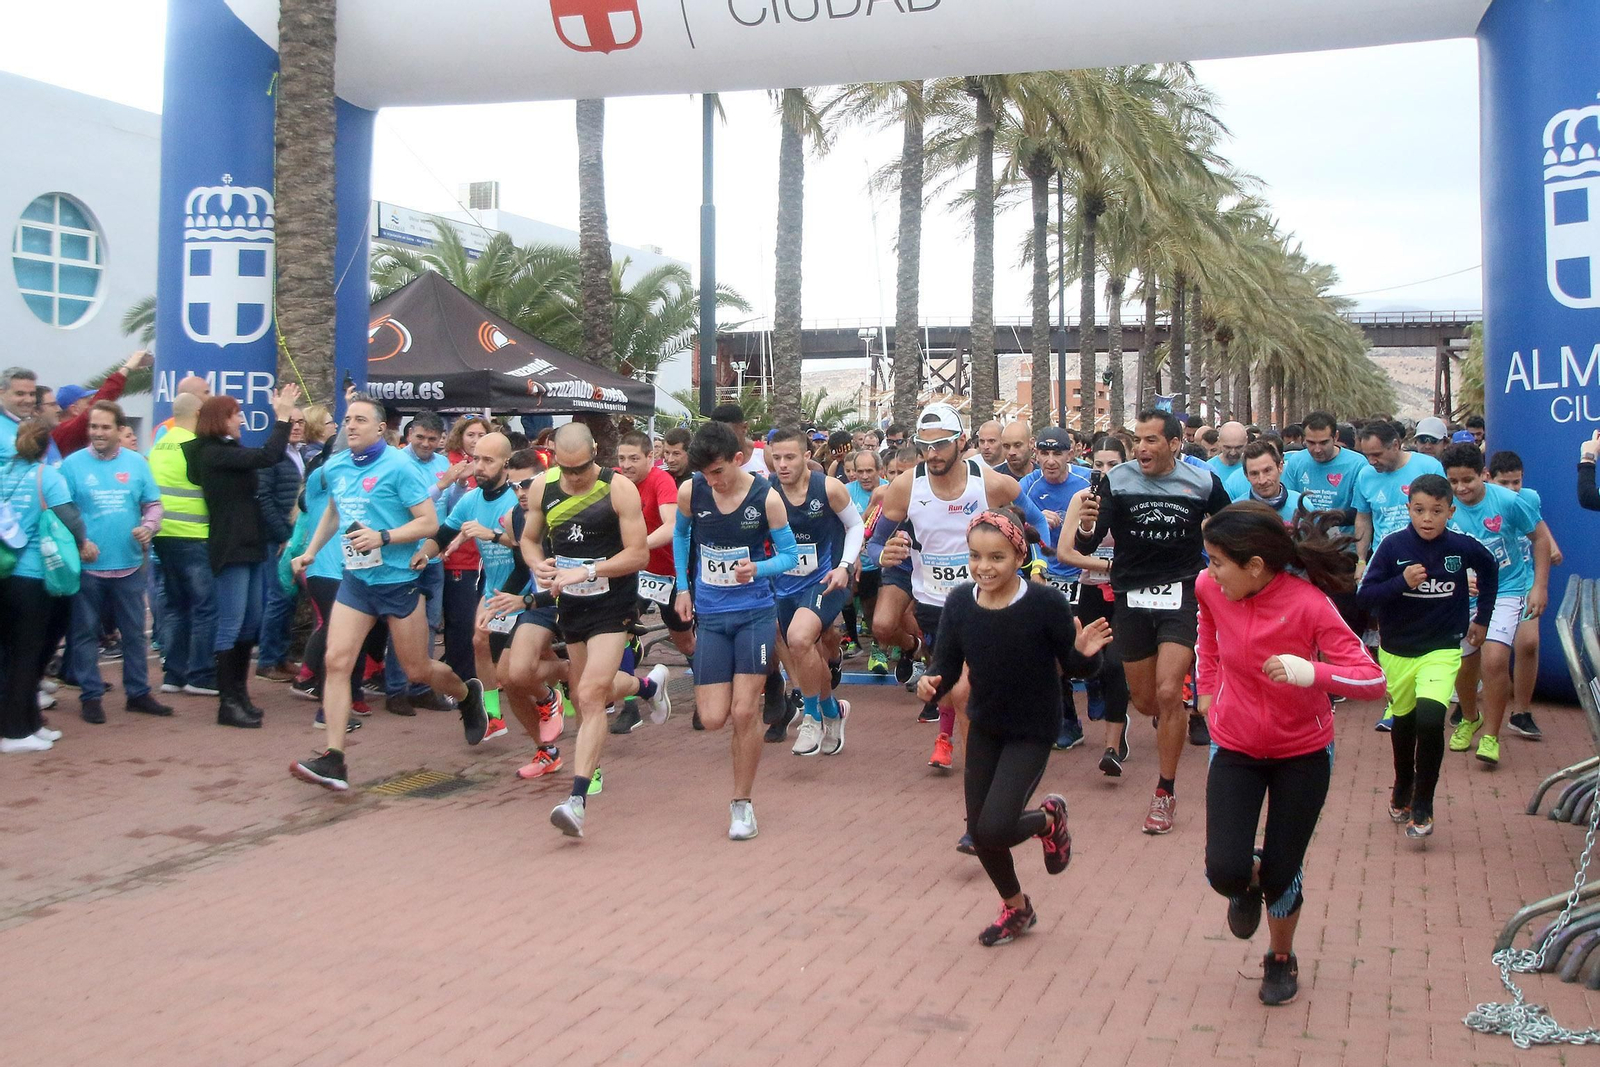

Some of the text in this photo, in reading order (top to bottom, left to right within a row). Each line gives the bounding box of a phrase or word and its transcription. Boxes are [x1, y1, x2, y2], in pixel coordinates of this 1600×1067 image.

[1504, 343, 1600, 394] ALM
[1550, 395, 1600, 423] CIU
[707, 559, 739, 574] 614
[932, 565, 969, 581] 584
[640, 578, 667, 592] 207
[1417, 578, 1456, 594] eko
